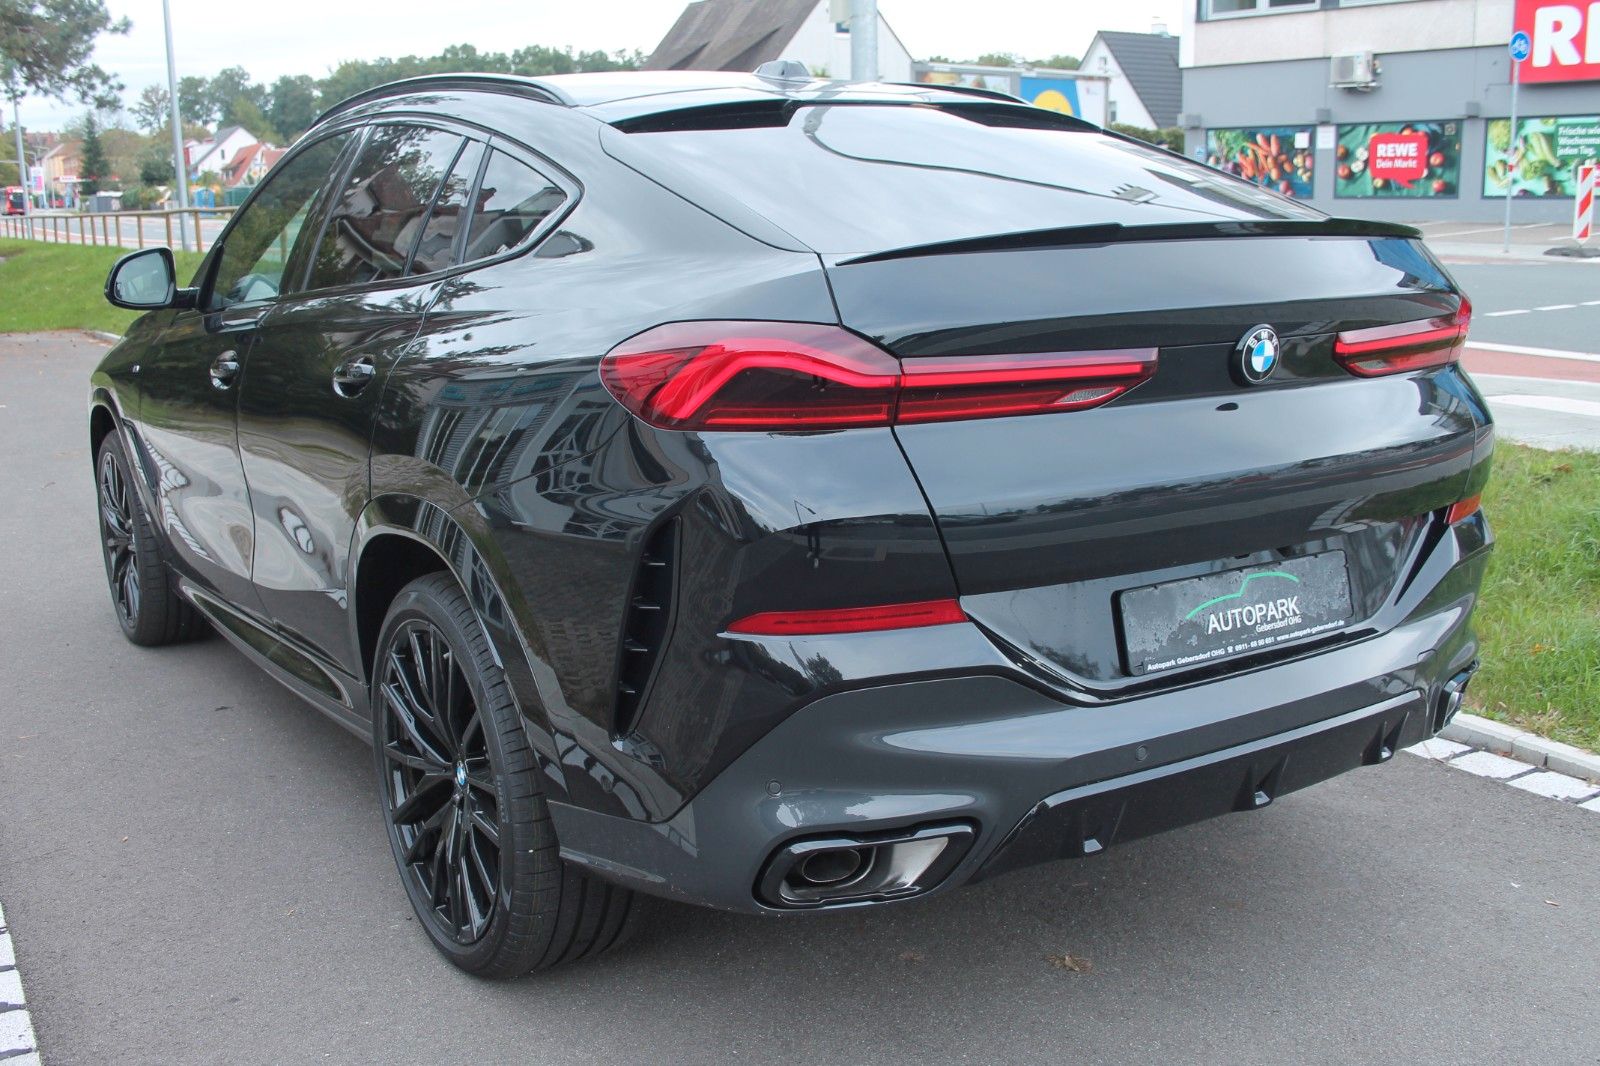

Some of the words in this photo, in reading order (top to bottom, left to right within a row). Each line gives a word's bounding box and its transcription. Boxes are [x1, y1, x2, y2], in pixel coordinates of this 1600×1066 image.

[1376, 143, 1418, 157] REWE
[1375, 158, 1393, 169] Dein
[1393, 158, 1418, 168] Markt
[1248, 330, 1278, 348] BMW
[1208, 596, 1300, 634] AUTOPARK
[1256, 617, 1288, 633] Gebersdorf
[1288, 615, 1302, 625] OHG
[1147, 659, 1176, 671] Autopark
[1176, 651, 1211, 665] Gebersdorf
[1210, 648, 1226, 657] OHG
